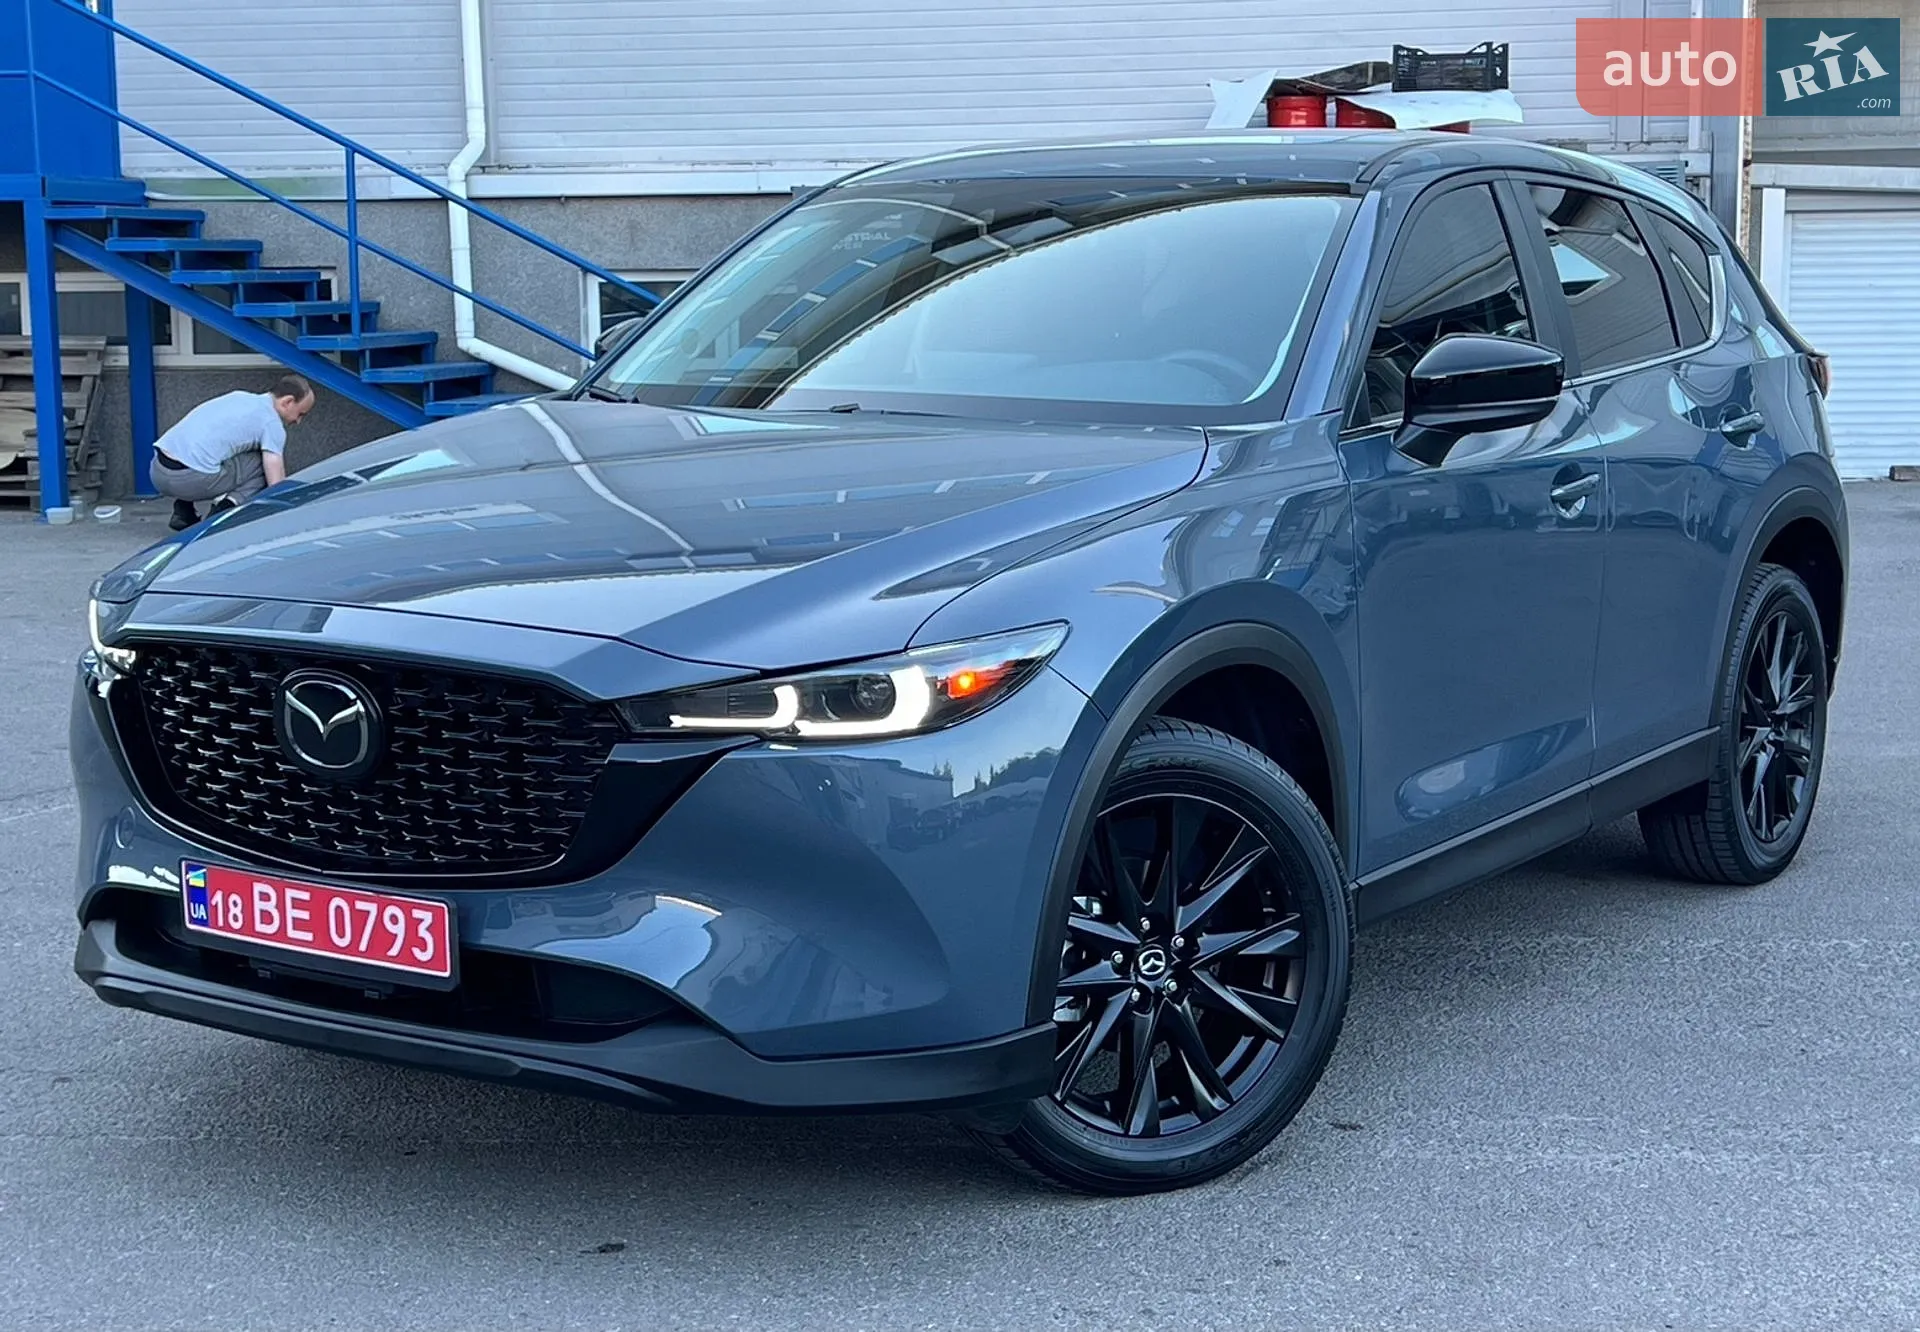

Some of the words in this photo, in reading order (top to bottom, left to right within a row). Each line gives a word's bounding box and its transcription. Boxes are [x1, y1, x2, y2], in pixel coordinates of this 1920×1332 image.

[190, 902, 208, 921] UA
[211, 890, 244, 930] 18
[252, 882, 314, 942] BE
[328, 896, 435, 962] 0793
